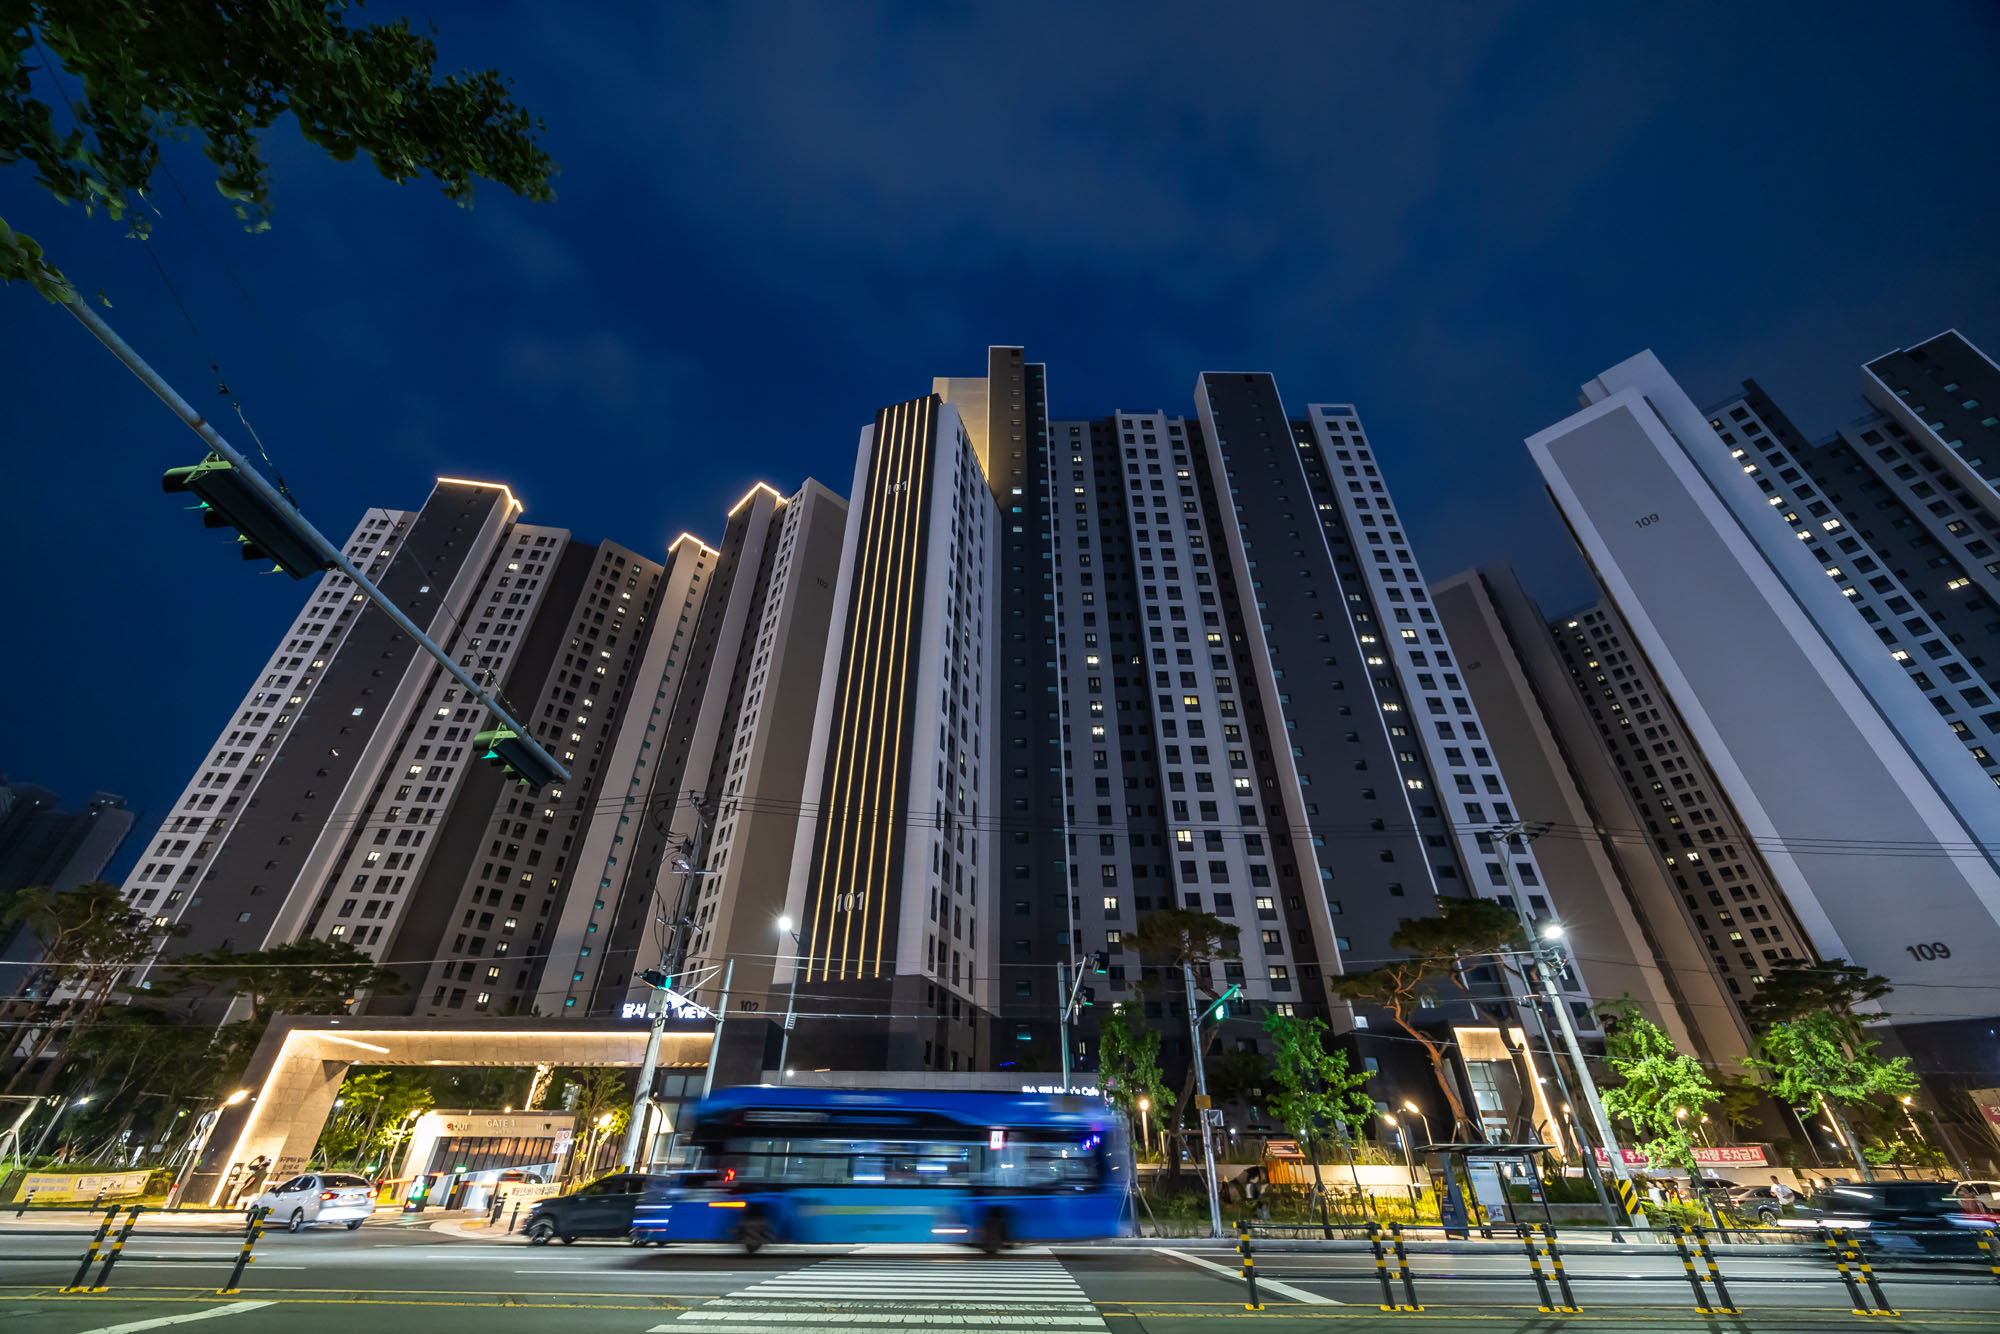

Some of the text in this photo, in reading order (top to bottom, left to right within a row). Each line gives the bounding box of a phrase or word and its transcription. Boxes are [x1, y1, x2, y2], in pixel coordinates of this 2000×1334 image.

[887, 480, 907, 495] 101
[1635, 513, 1659, 528] 109
[836, 891, 864, 912] 101
[1906, 942, 1951, 961] 109
[677, 1006, 710, 1019] VIEW
[740, 1000, 759, 1012] 102
[486, 1118, 508, 1128] GATE
[1721, 1148, 1761, 1161] 주차금지
